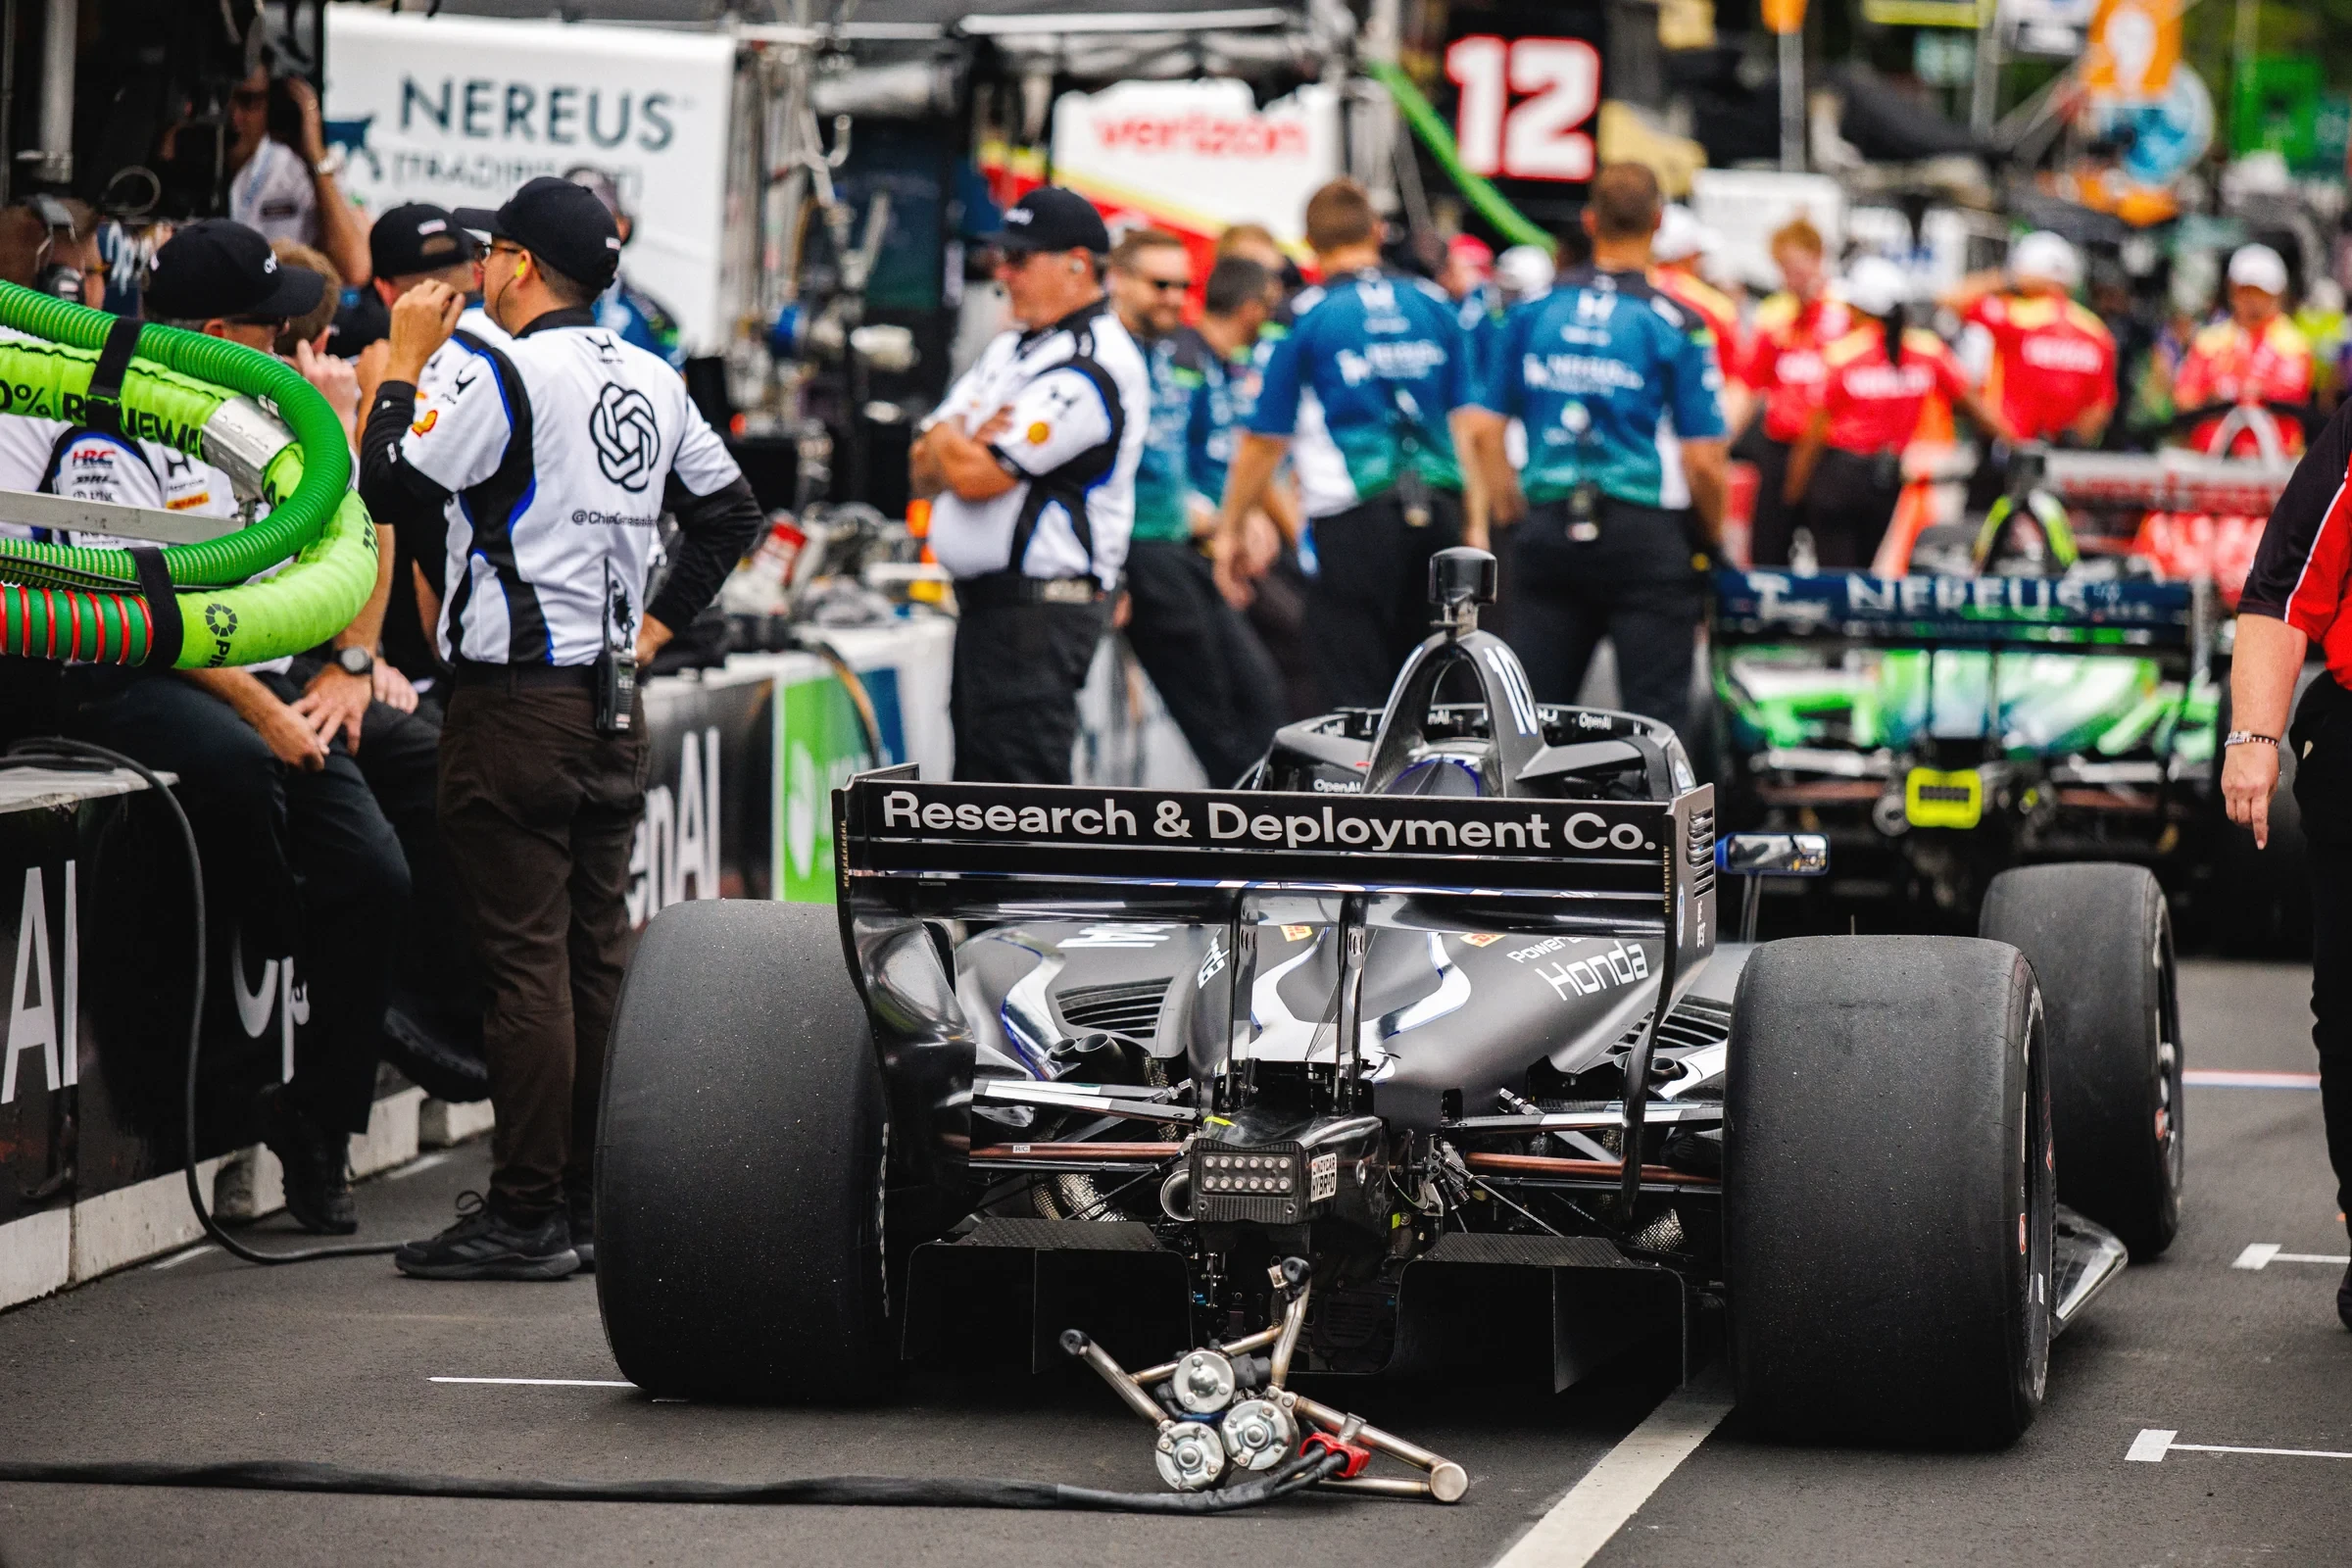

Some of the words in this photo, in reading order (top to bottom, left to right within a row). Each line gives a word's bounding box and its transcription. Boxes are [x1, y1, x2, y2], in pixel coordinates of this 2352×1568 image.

[400, 71, 677, 152] NEREUS
[1445, 32, 1601, 183] 12
[73, 449, 116, 466] HRC
[1483, 645, 1539, 736] 10
[1313, 778, 1361, 794] OpenAI
[883, 790, 1137, 836] Research
[1152, 800, 1193, 838] &
[1207, 802, 1551, 852] Deployment
[1563, 811, 1656, 851] Co.
[1535, 940, 1649, 1002] Honda
[1311, 1171, 1336, 1199] HYBRID
[1313, 1156, 1336, 1175] INDYCAR
